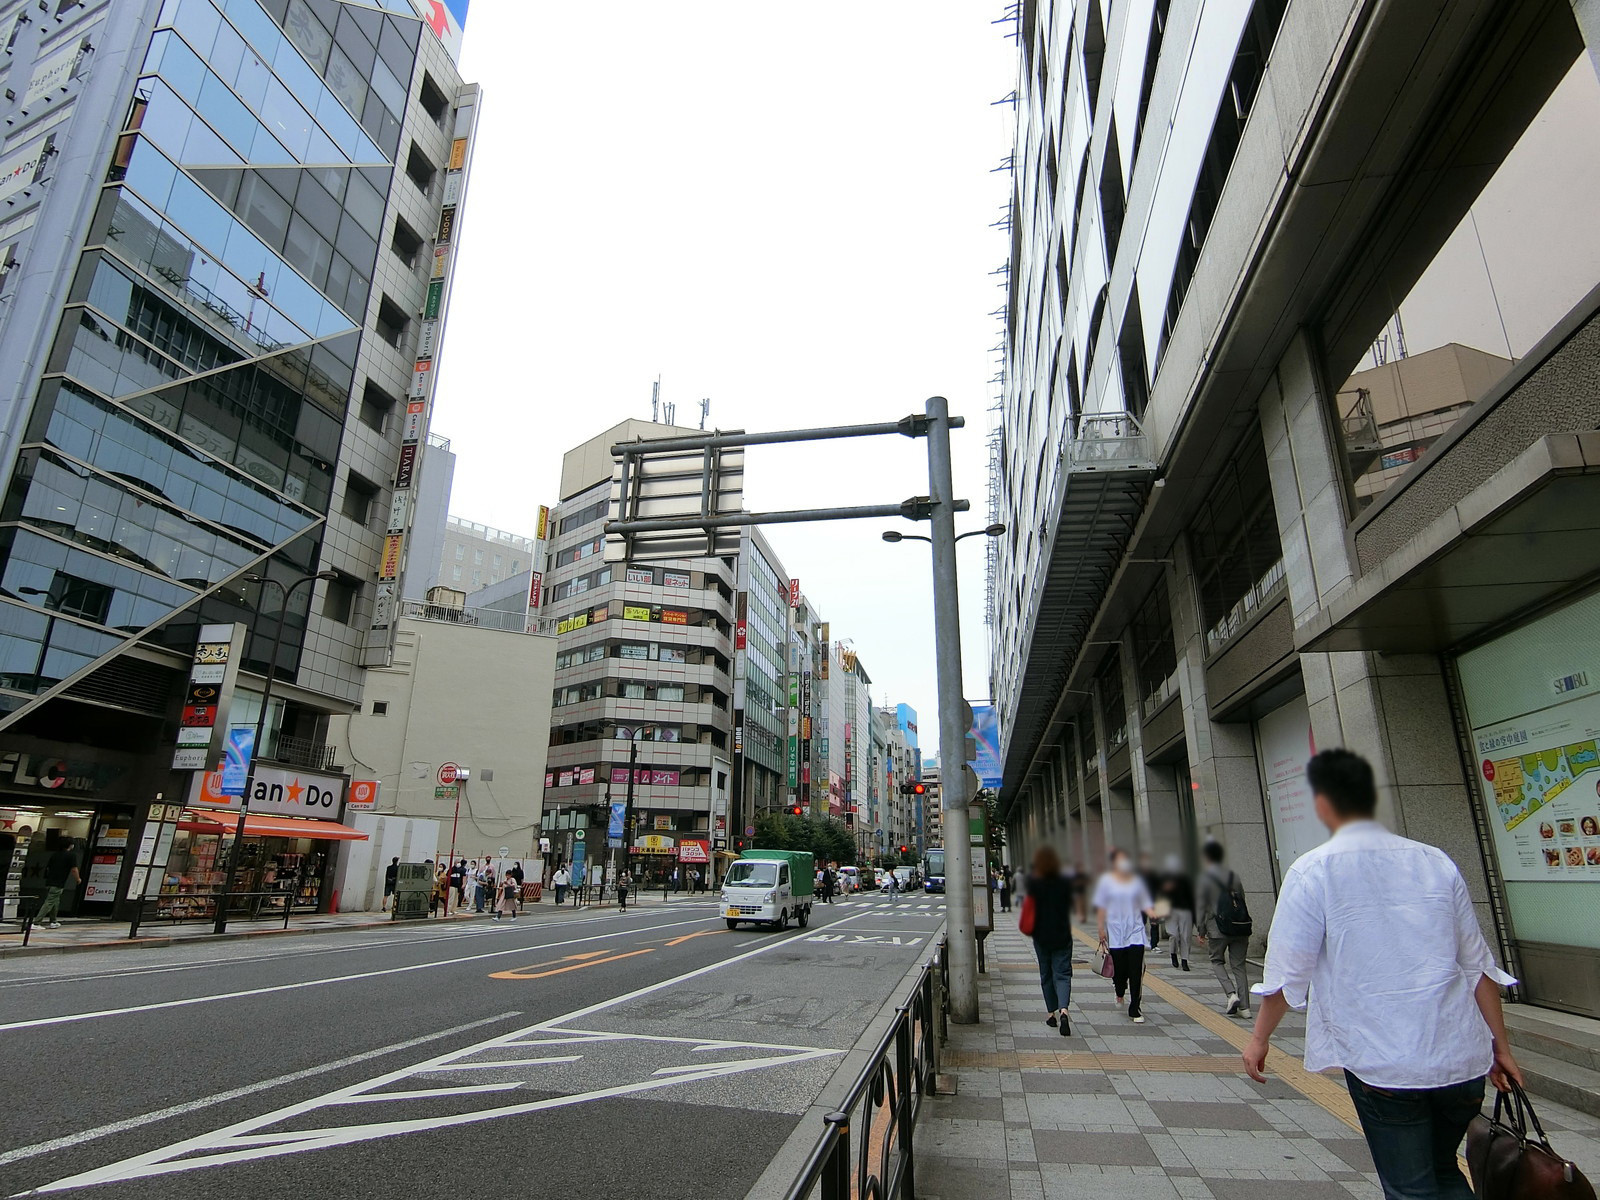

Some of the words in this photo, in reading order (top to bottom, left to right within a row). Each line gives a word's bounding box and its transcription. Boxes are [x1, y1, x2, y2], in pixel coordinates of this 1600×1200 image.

[400, 447, 413, 481] TIARA
[175, 753, 208, 763] Euphoria
[249, 781, 284, 803] an
[306, 785, 333, 808] Do
